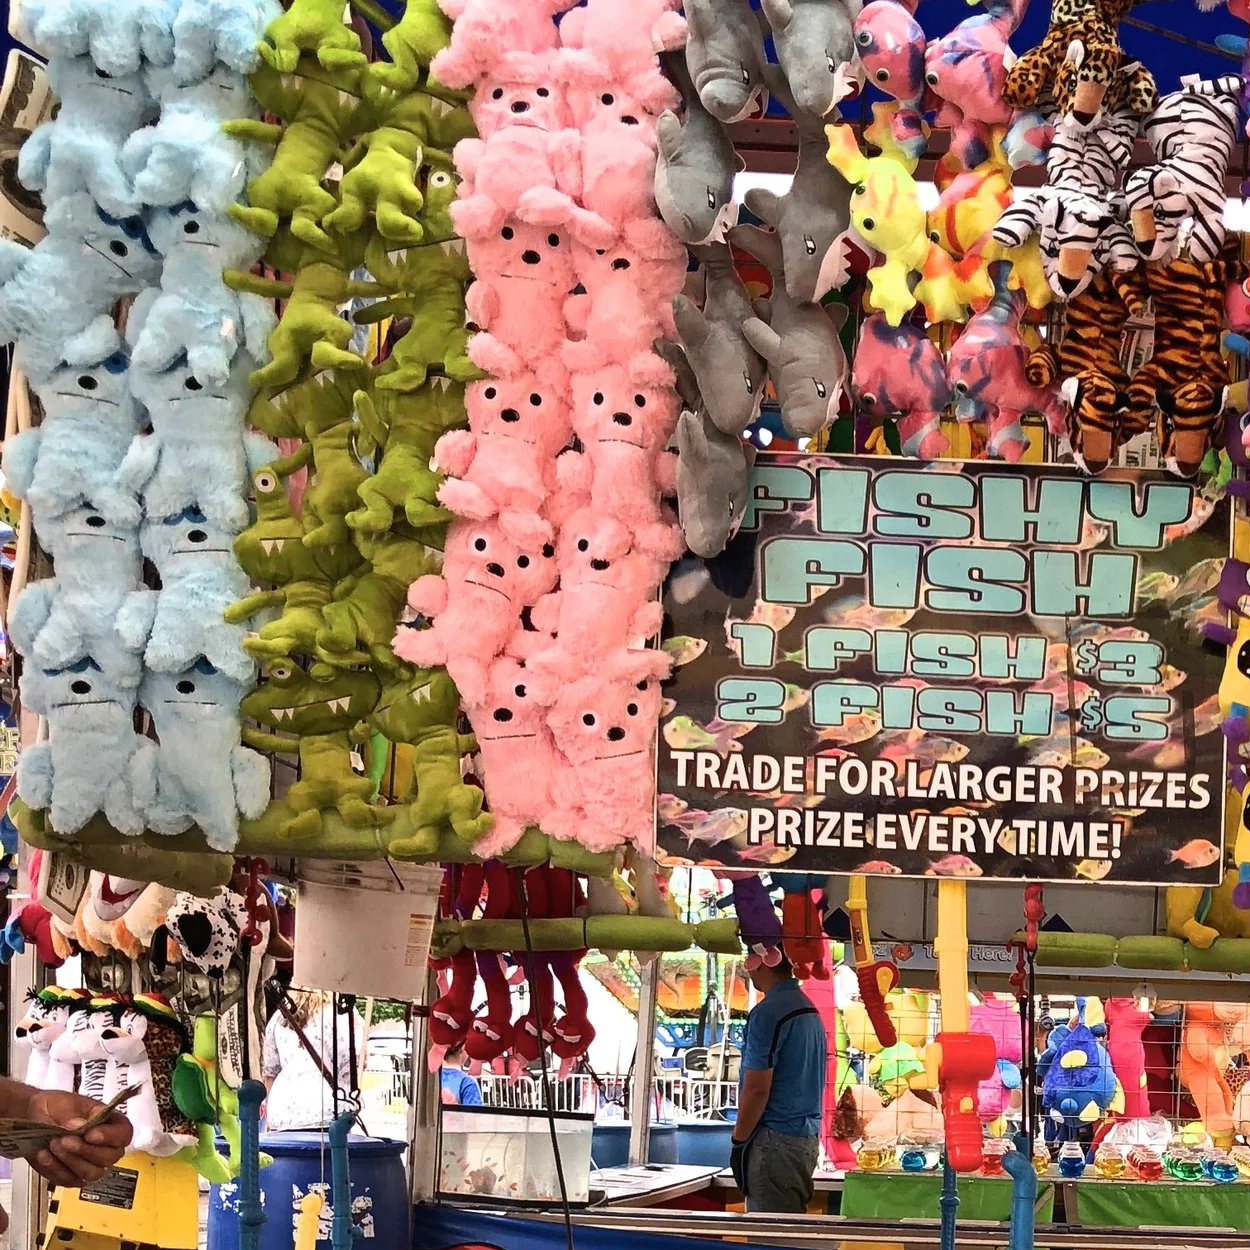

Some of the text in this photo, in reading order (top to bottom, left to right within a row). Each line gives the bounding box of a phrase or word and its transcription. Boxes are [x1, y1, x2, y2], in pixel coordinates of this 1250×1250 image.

[741, 464, 1191, 548] FISHY
[760, 537, 1140, 619] FISH
[731, 623, 1164, 685] 1 FISH $3
[717, 678, 1172, 740] 2 FISH $5
[670, 751, 1210, 809] TRADE FOR LARGER PRIZES
[749, 807, 1122, 860] PRIZE EVERY TIME!
[970, 947, 1013, 962] Here!
